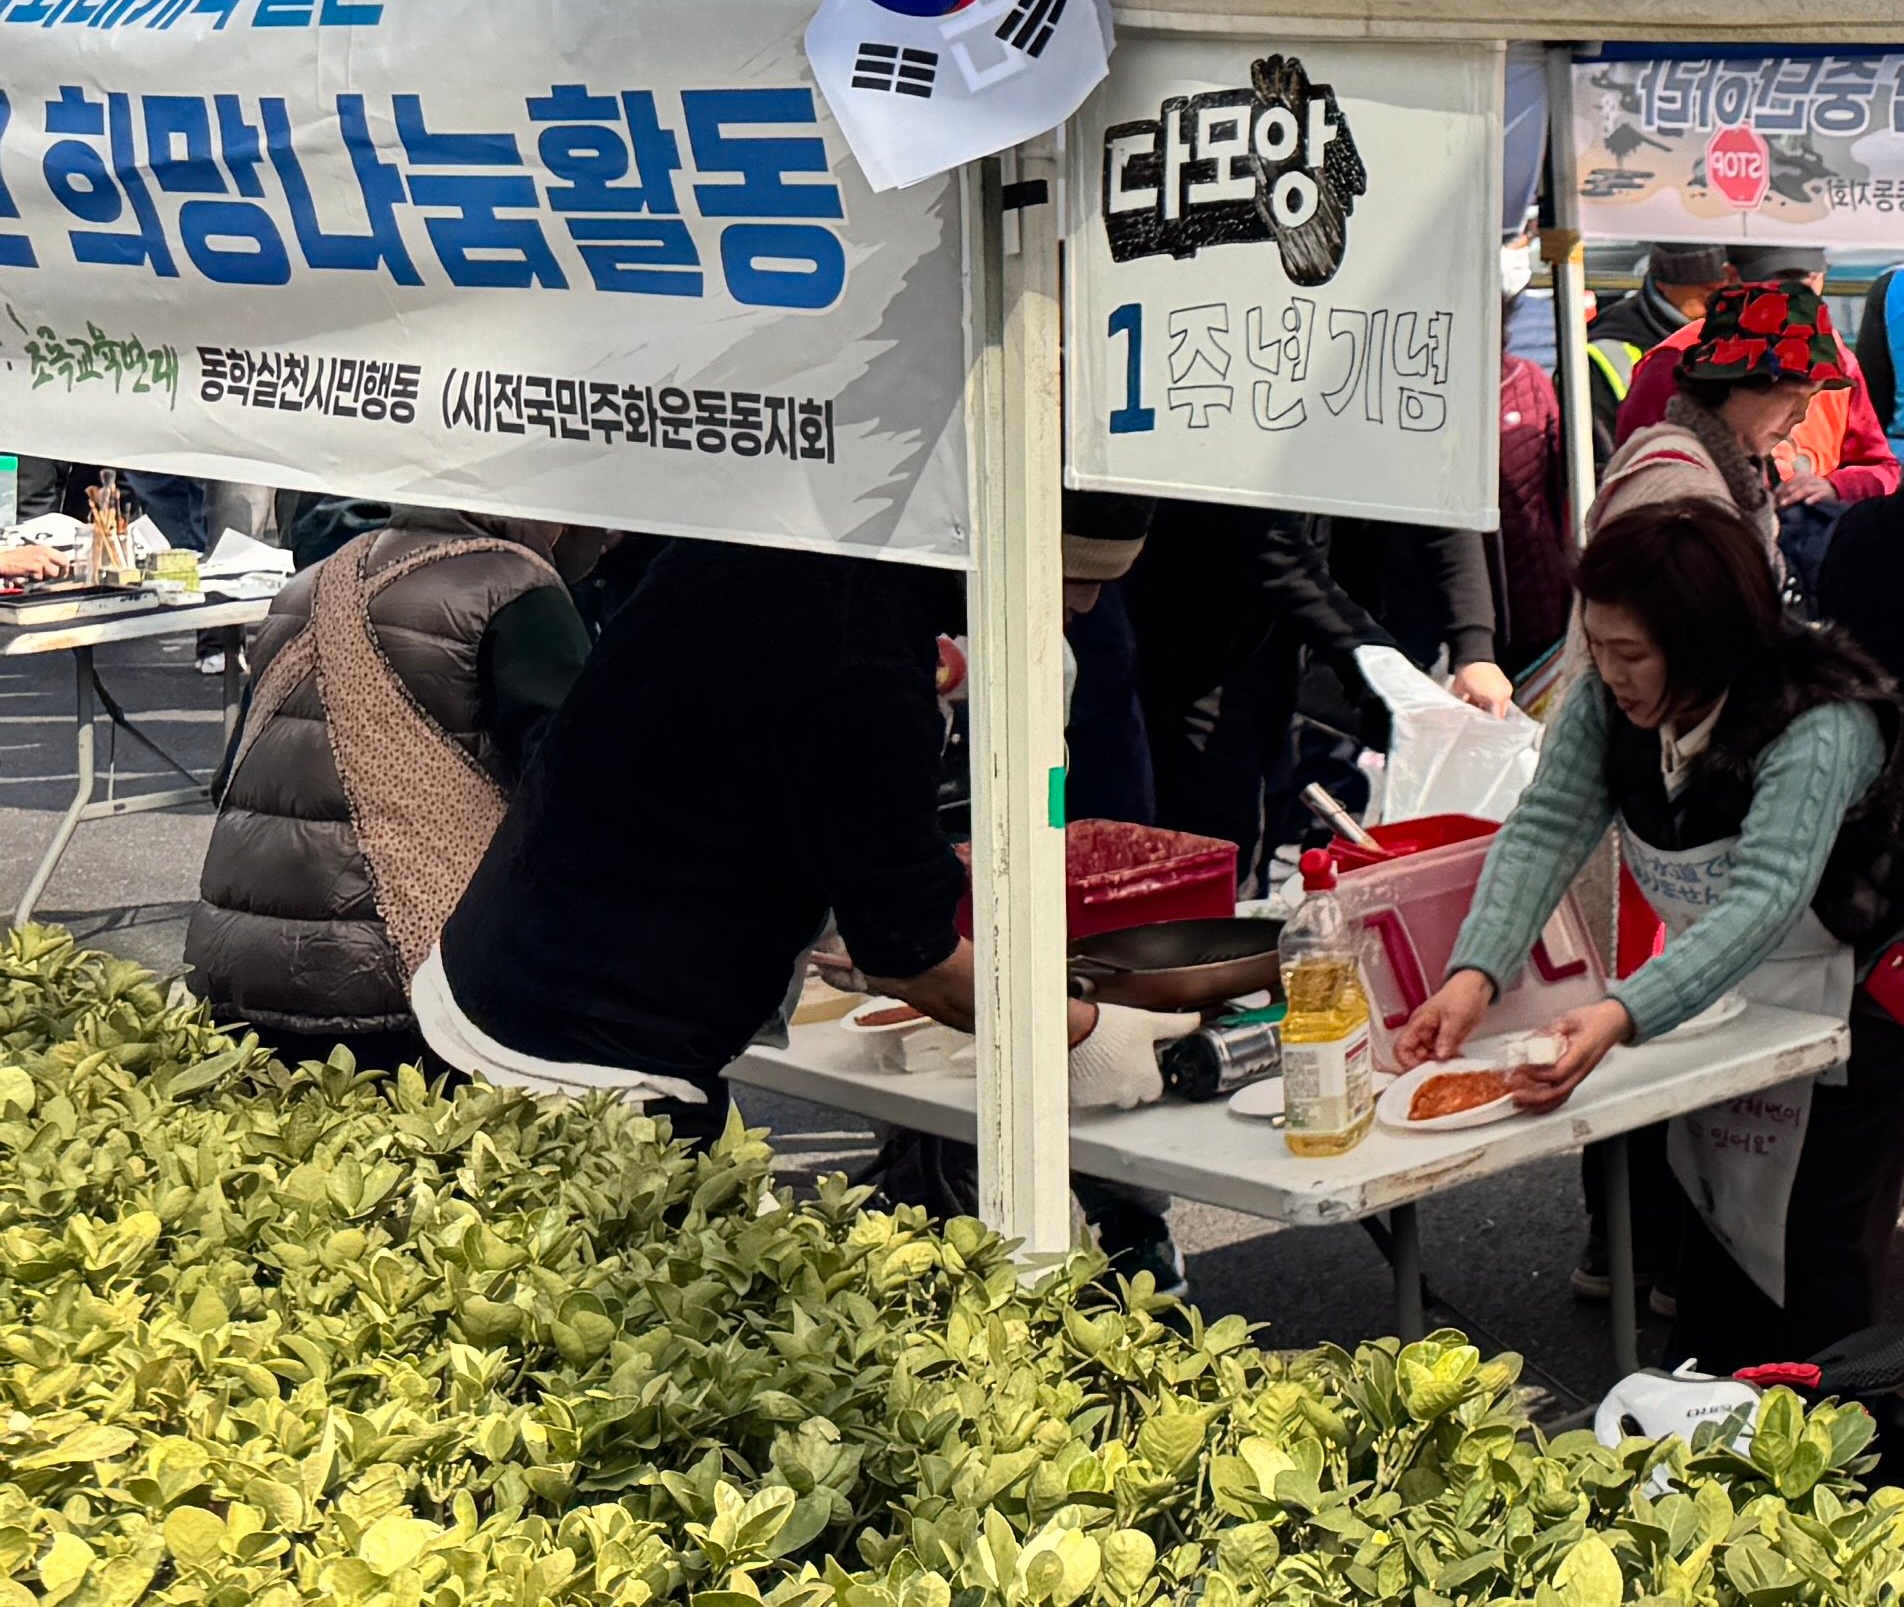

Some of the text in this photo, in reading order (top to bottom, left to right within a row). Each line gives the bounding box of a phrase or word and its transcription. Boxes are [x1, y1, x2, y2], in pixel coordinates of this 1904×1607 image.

[43, 85, 846, 308] 희망나눔활동
[1108, 98, 1338, 228] 다모앙
[197, 345, 422, 425] 동학실천시민행동
[441, 367, 836, 463] (사)전국민주화운동동지회
